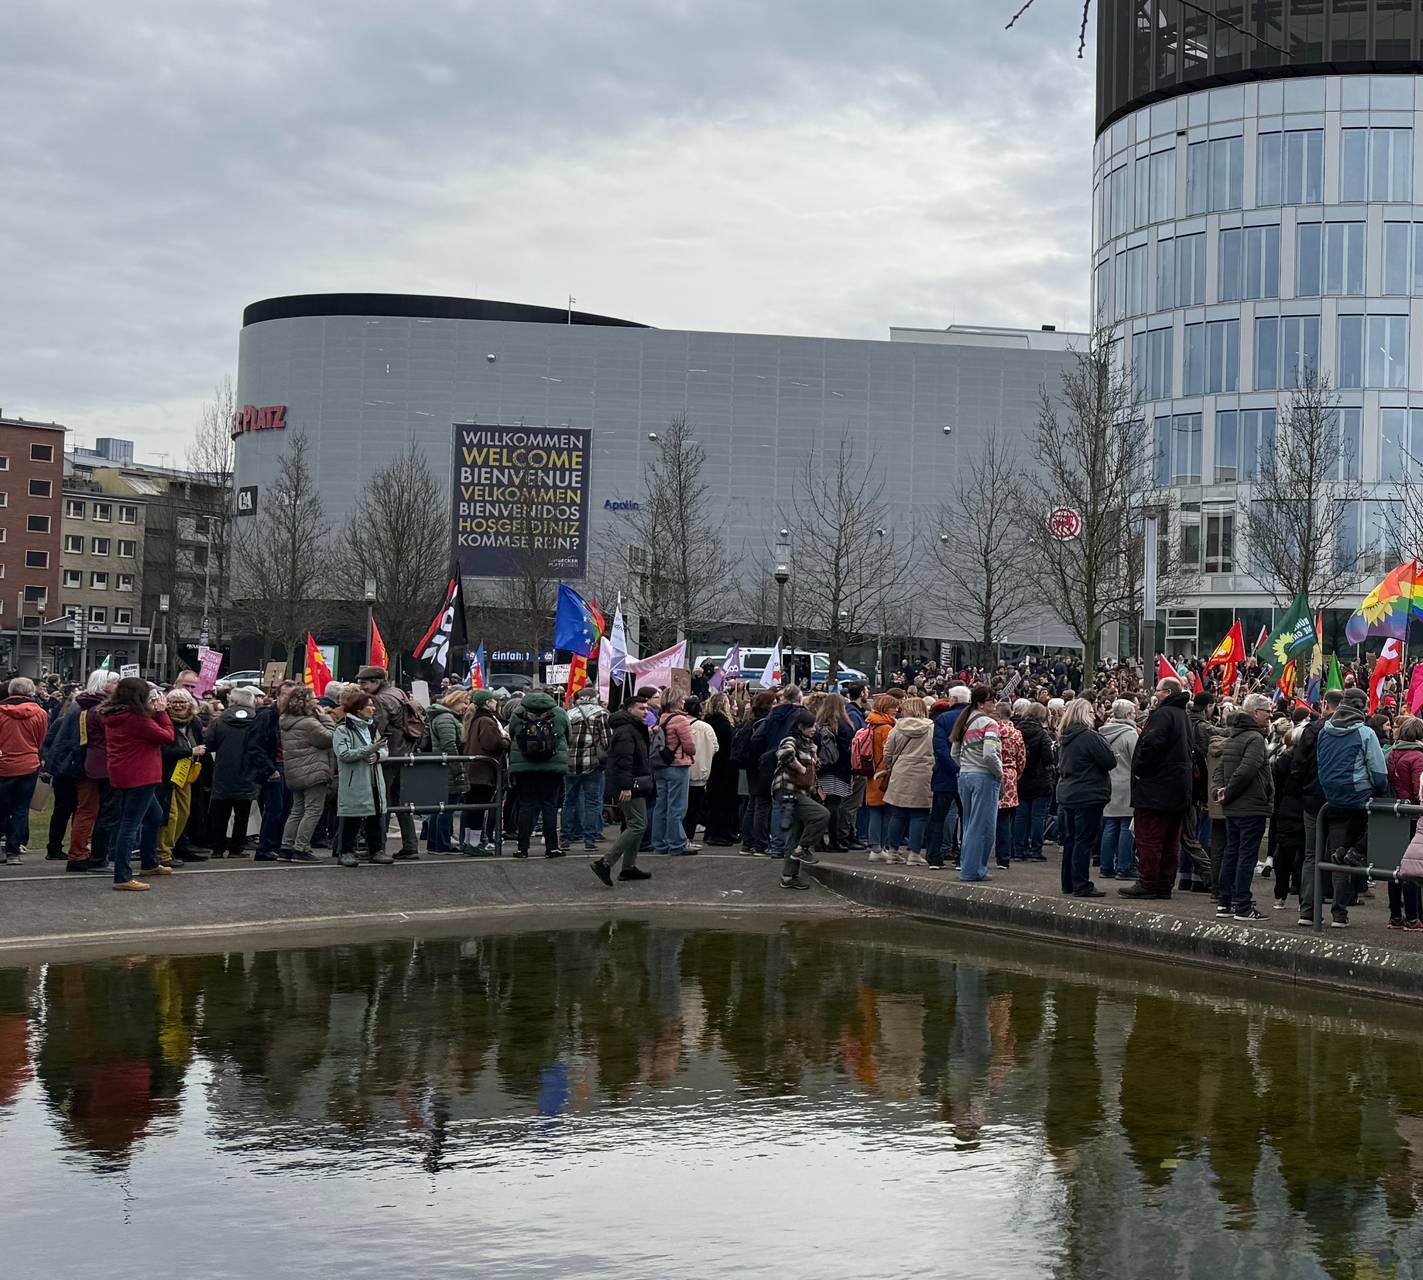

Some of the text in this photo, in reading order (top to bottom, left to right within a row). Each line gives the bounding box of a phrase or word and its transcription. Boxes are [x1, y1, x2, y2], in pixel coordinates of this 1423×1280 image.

[243, 404, 286, 431] PLATZ
[462, 431, 583, 449] WILLKOMMEN
[462, 446, 583, 469] WELCOME
[460, 467, 582, 488] BIENVENUE
[460, 485, 581, 504] VELKOMMEN
[459, 502, 580, 520] BIENVENIDOS
